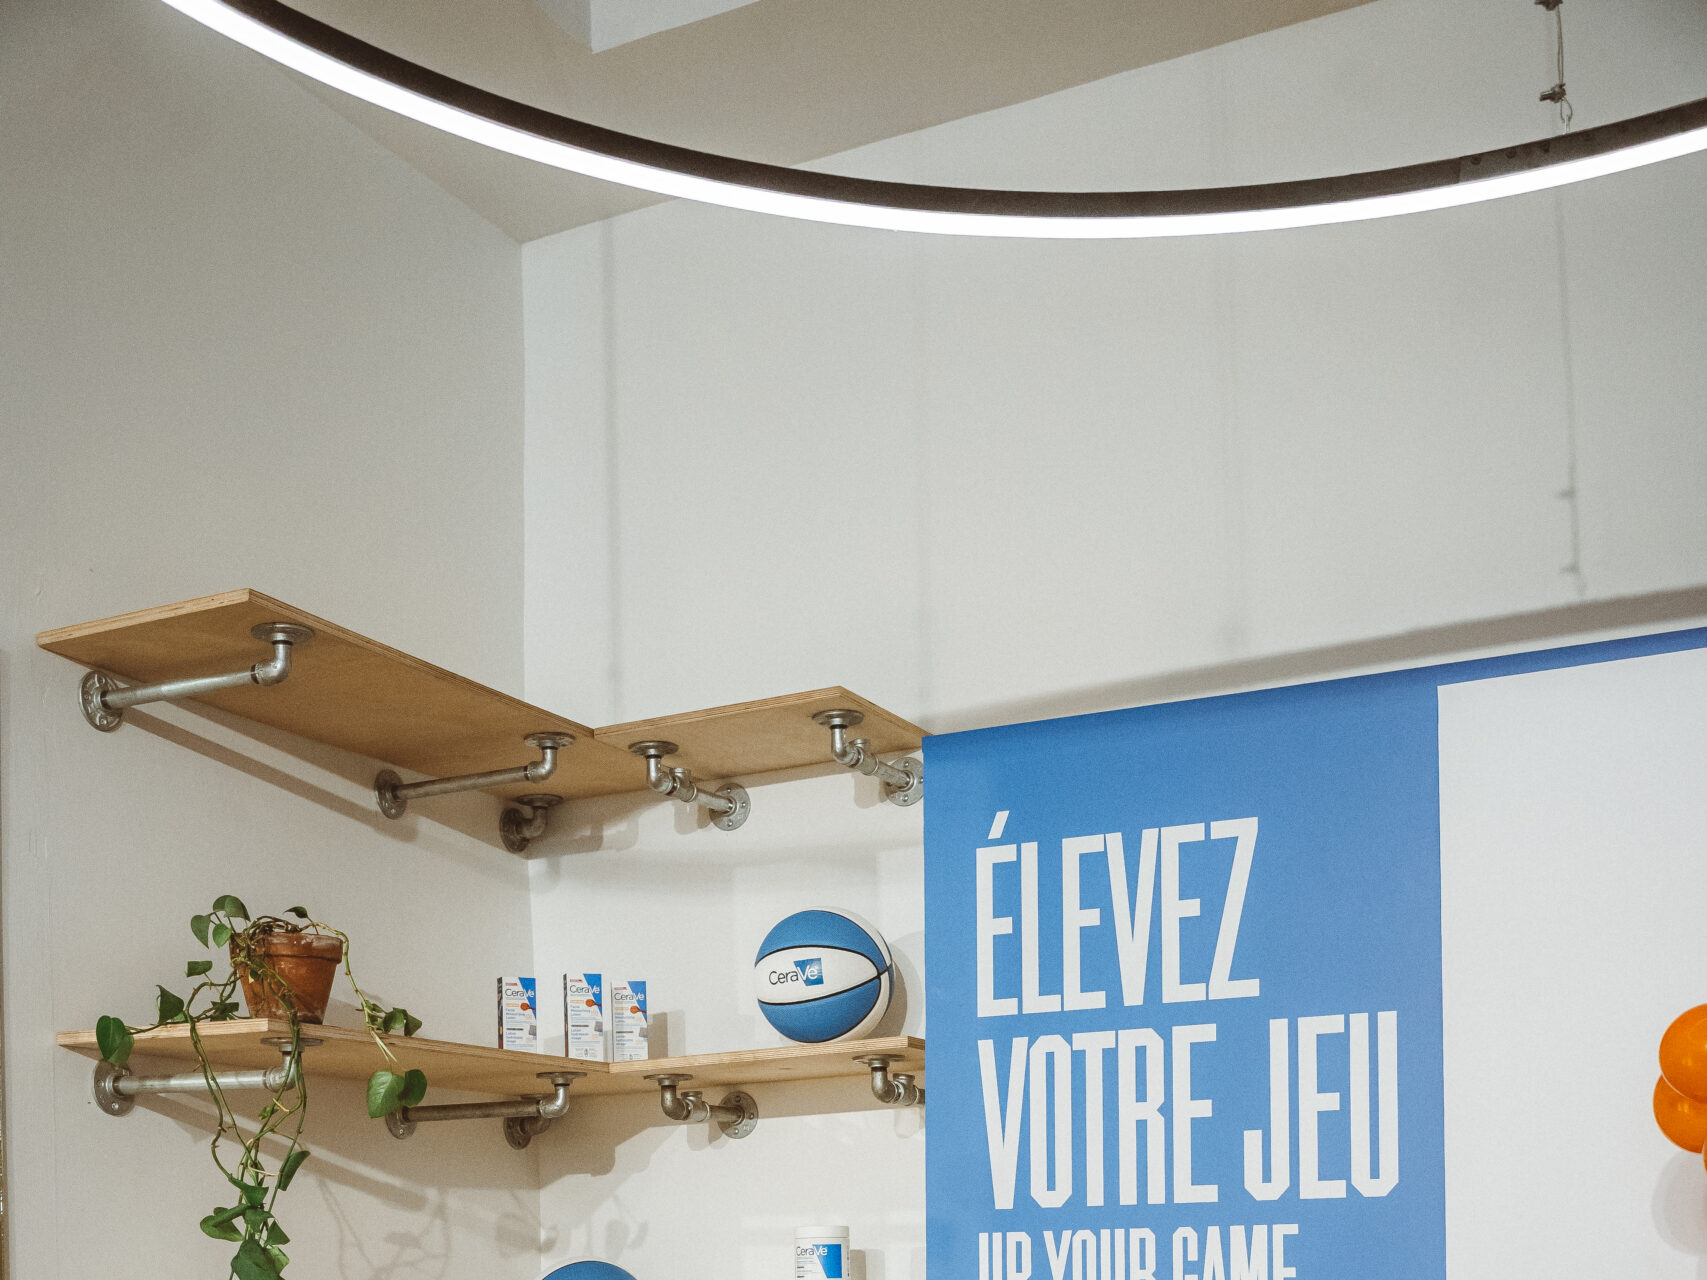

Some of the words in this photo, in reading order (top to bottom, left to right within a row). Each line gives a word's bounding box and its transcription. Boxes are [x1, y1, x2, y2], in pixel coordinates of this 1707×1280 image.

[976, 811, 1259, 1017] ÉLEVEZ
[768, 964, 818, 985] CeraVe
[570, 984, 600, 994] CeraVe
[977, 1024, 1218, 1209] VOTRE
[1244, 1011, 1399, 1200] JEU
[796, 1246, 828, 1256] CeraVe
